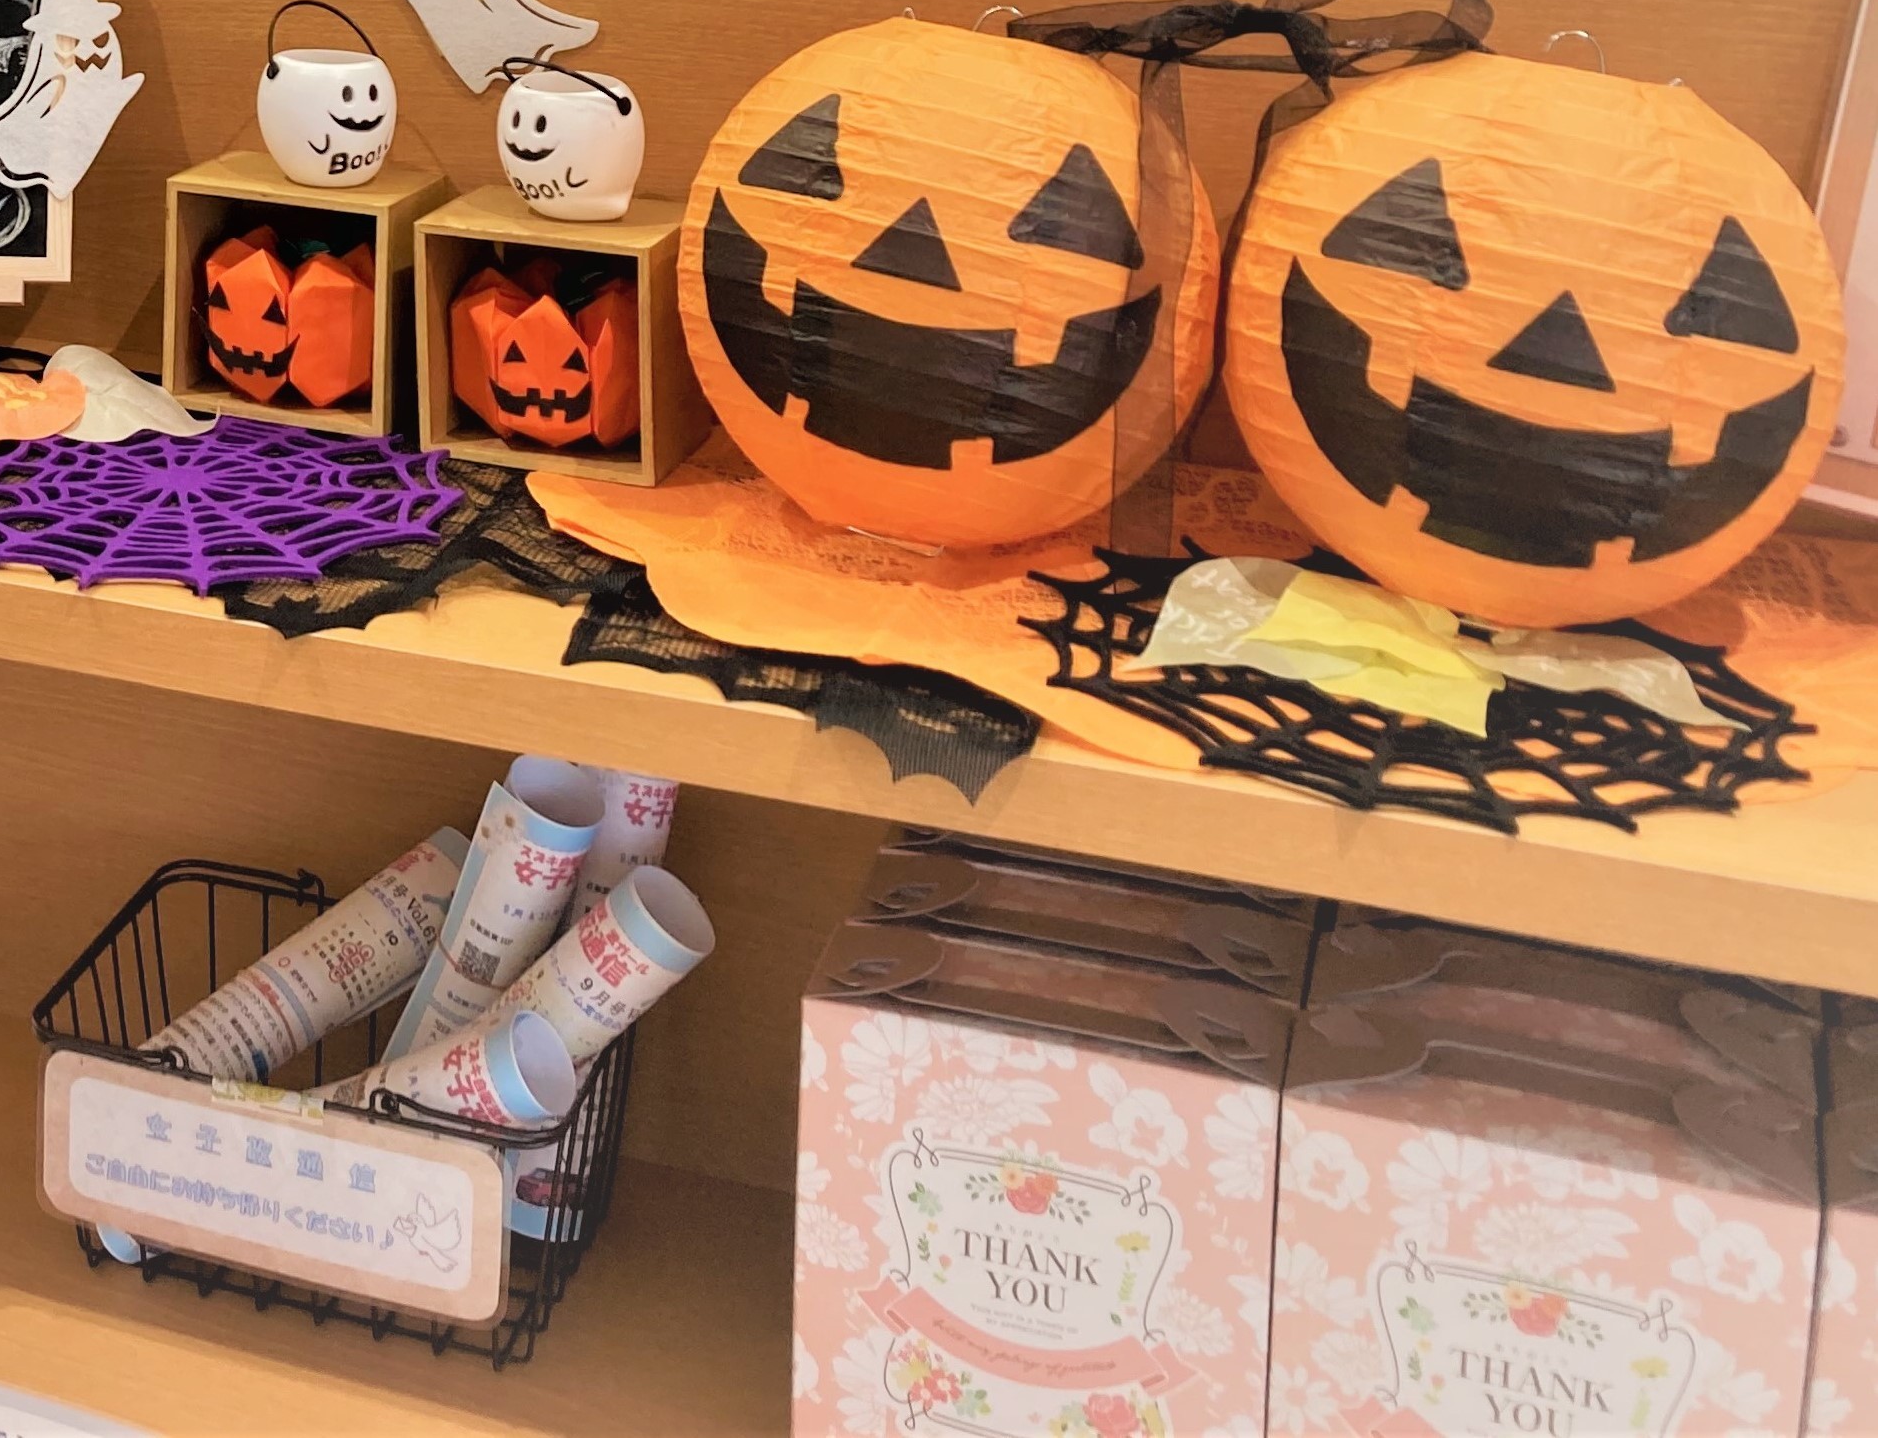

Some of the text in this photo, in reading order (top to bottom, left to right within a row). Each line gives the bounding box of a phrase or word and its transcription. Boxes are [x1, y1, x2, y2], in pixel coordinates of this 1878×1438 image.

[328, 145, 383, 175] Boo!
[512, 177, 564, 201] Boo!
[954, 1229, 1101, 1286] THANK
[986, 1269, 1066, 1313] YOU
[1450, 1345, 1614, 1413] THANK
[1485, 1392, 1575, 1438] YOU
